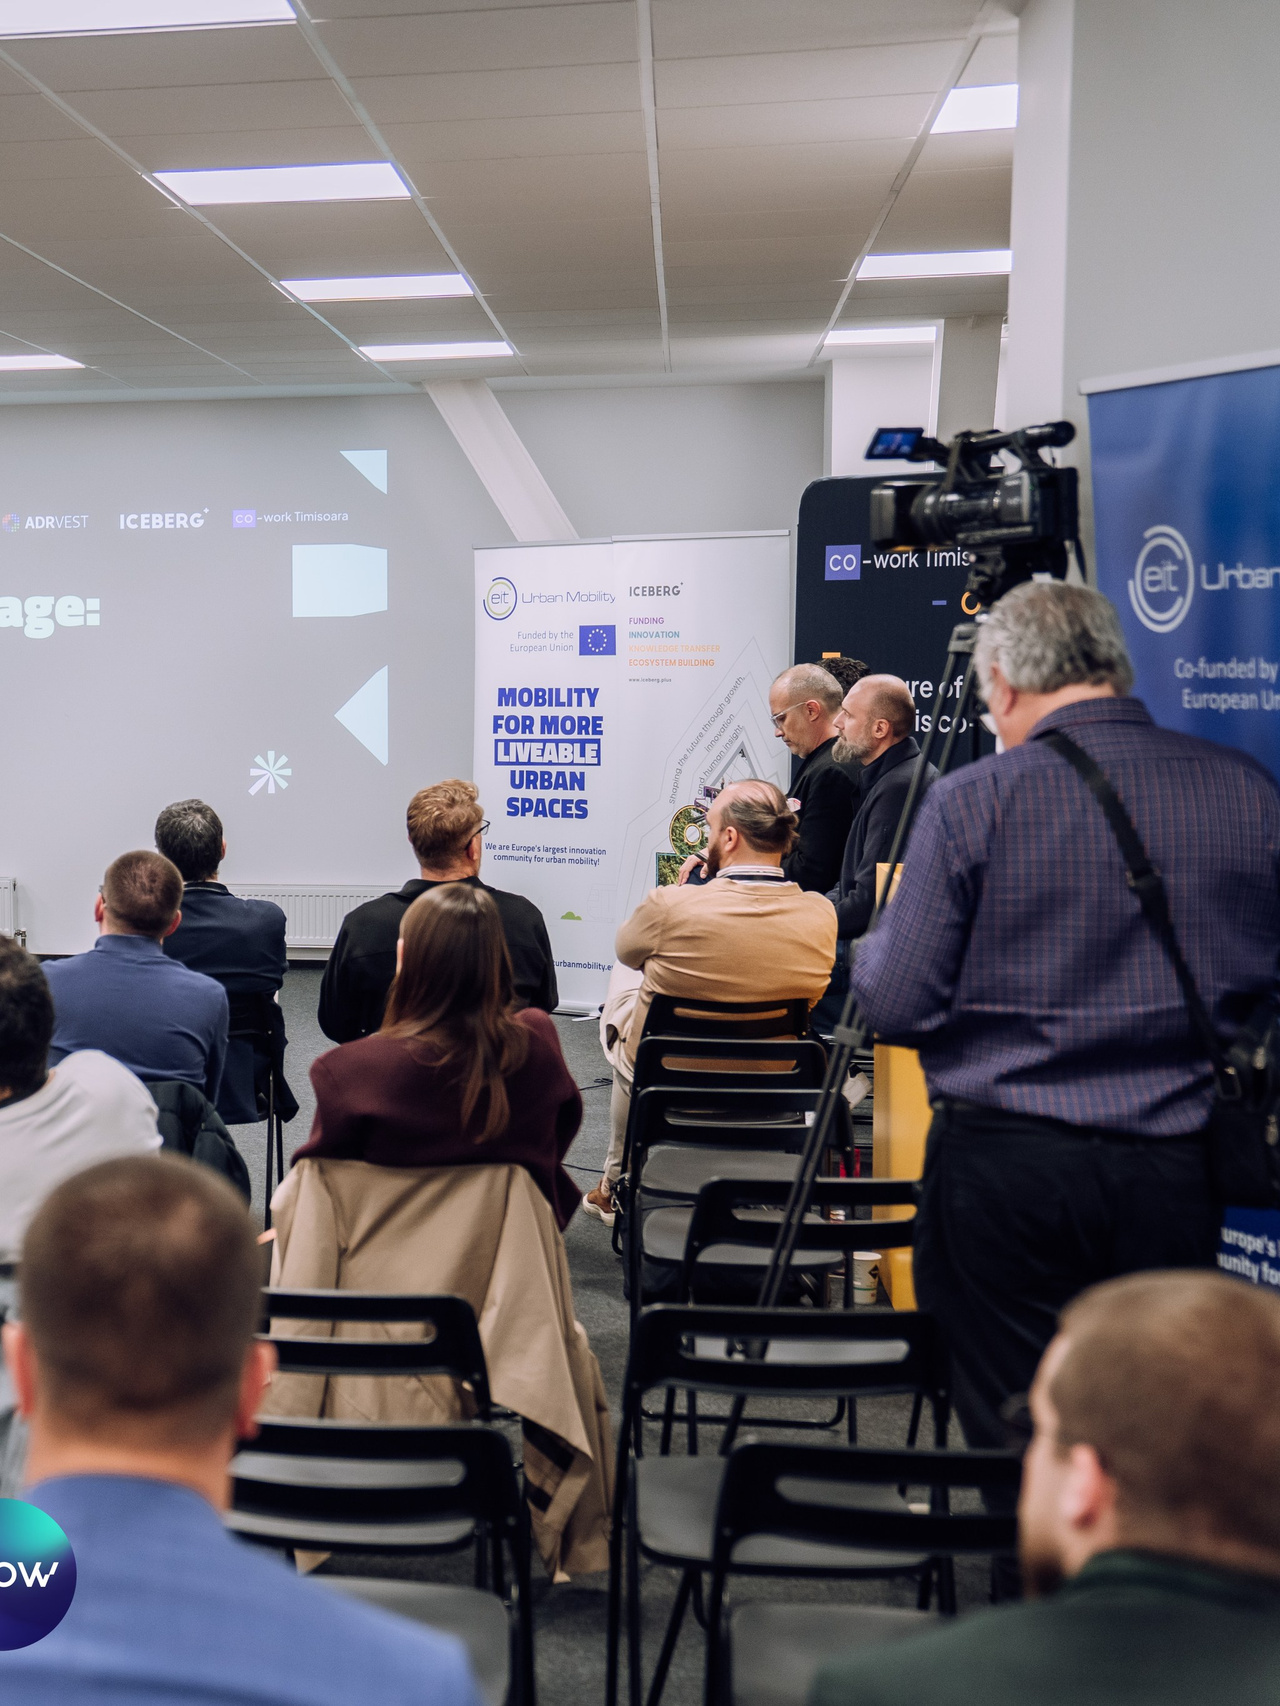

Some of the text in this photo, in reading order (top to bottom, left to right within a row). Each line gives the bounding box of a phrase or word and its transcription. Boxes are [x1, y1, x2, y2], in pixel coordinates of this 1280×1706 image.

[24, 514, 89, 529] ADRVEST
[294, 511, 349, 522] Timisoara
[1143, 560, 1179, 593] eit
[491, 591, 616, 604] eit Urban Mobility
[518, 630, 574, 640] Funded by the
[510, 644, 574, 653] European Union
[629, 644, 720, 652] KNOWLEDGE TRANSFER
[1173, 656, 1256, 680] Co-funded
[497, 687, 600, 708] MOBILITY
[1182, 688, 1258, 714] European
[493, 715, 604, 736] FOR MORE
[705, 714, 735, 752] innovation
[669, 676, 746, 804] Shaping the future through growth,
[497, 742, 598, 764] LIVEABLE
[704, 748, 726, 777] human
[510, 770, 586, 791] URBAN
[506, 797, 588, 819] SPACES
[485, 842, 496, 850] We
[512, 844, 541, 854] Europe's
[542, 845, 568, 856] largest
[568, 846, 606, 856] innovation
[494, 854, 532, 864] community
[546, 856, 566, 864] urban
[568, 856, 600, 867] mobility!
[553, 960, 613, 972] urbanmobility.e
